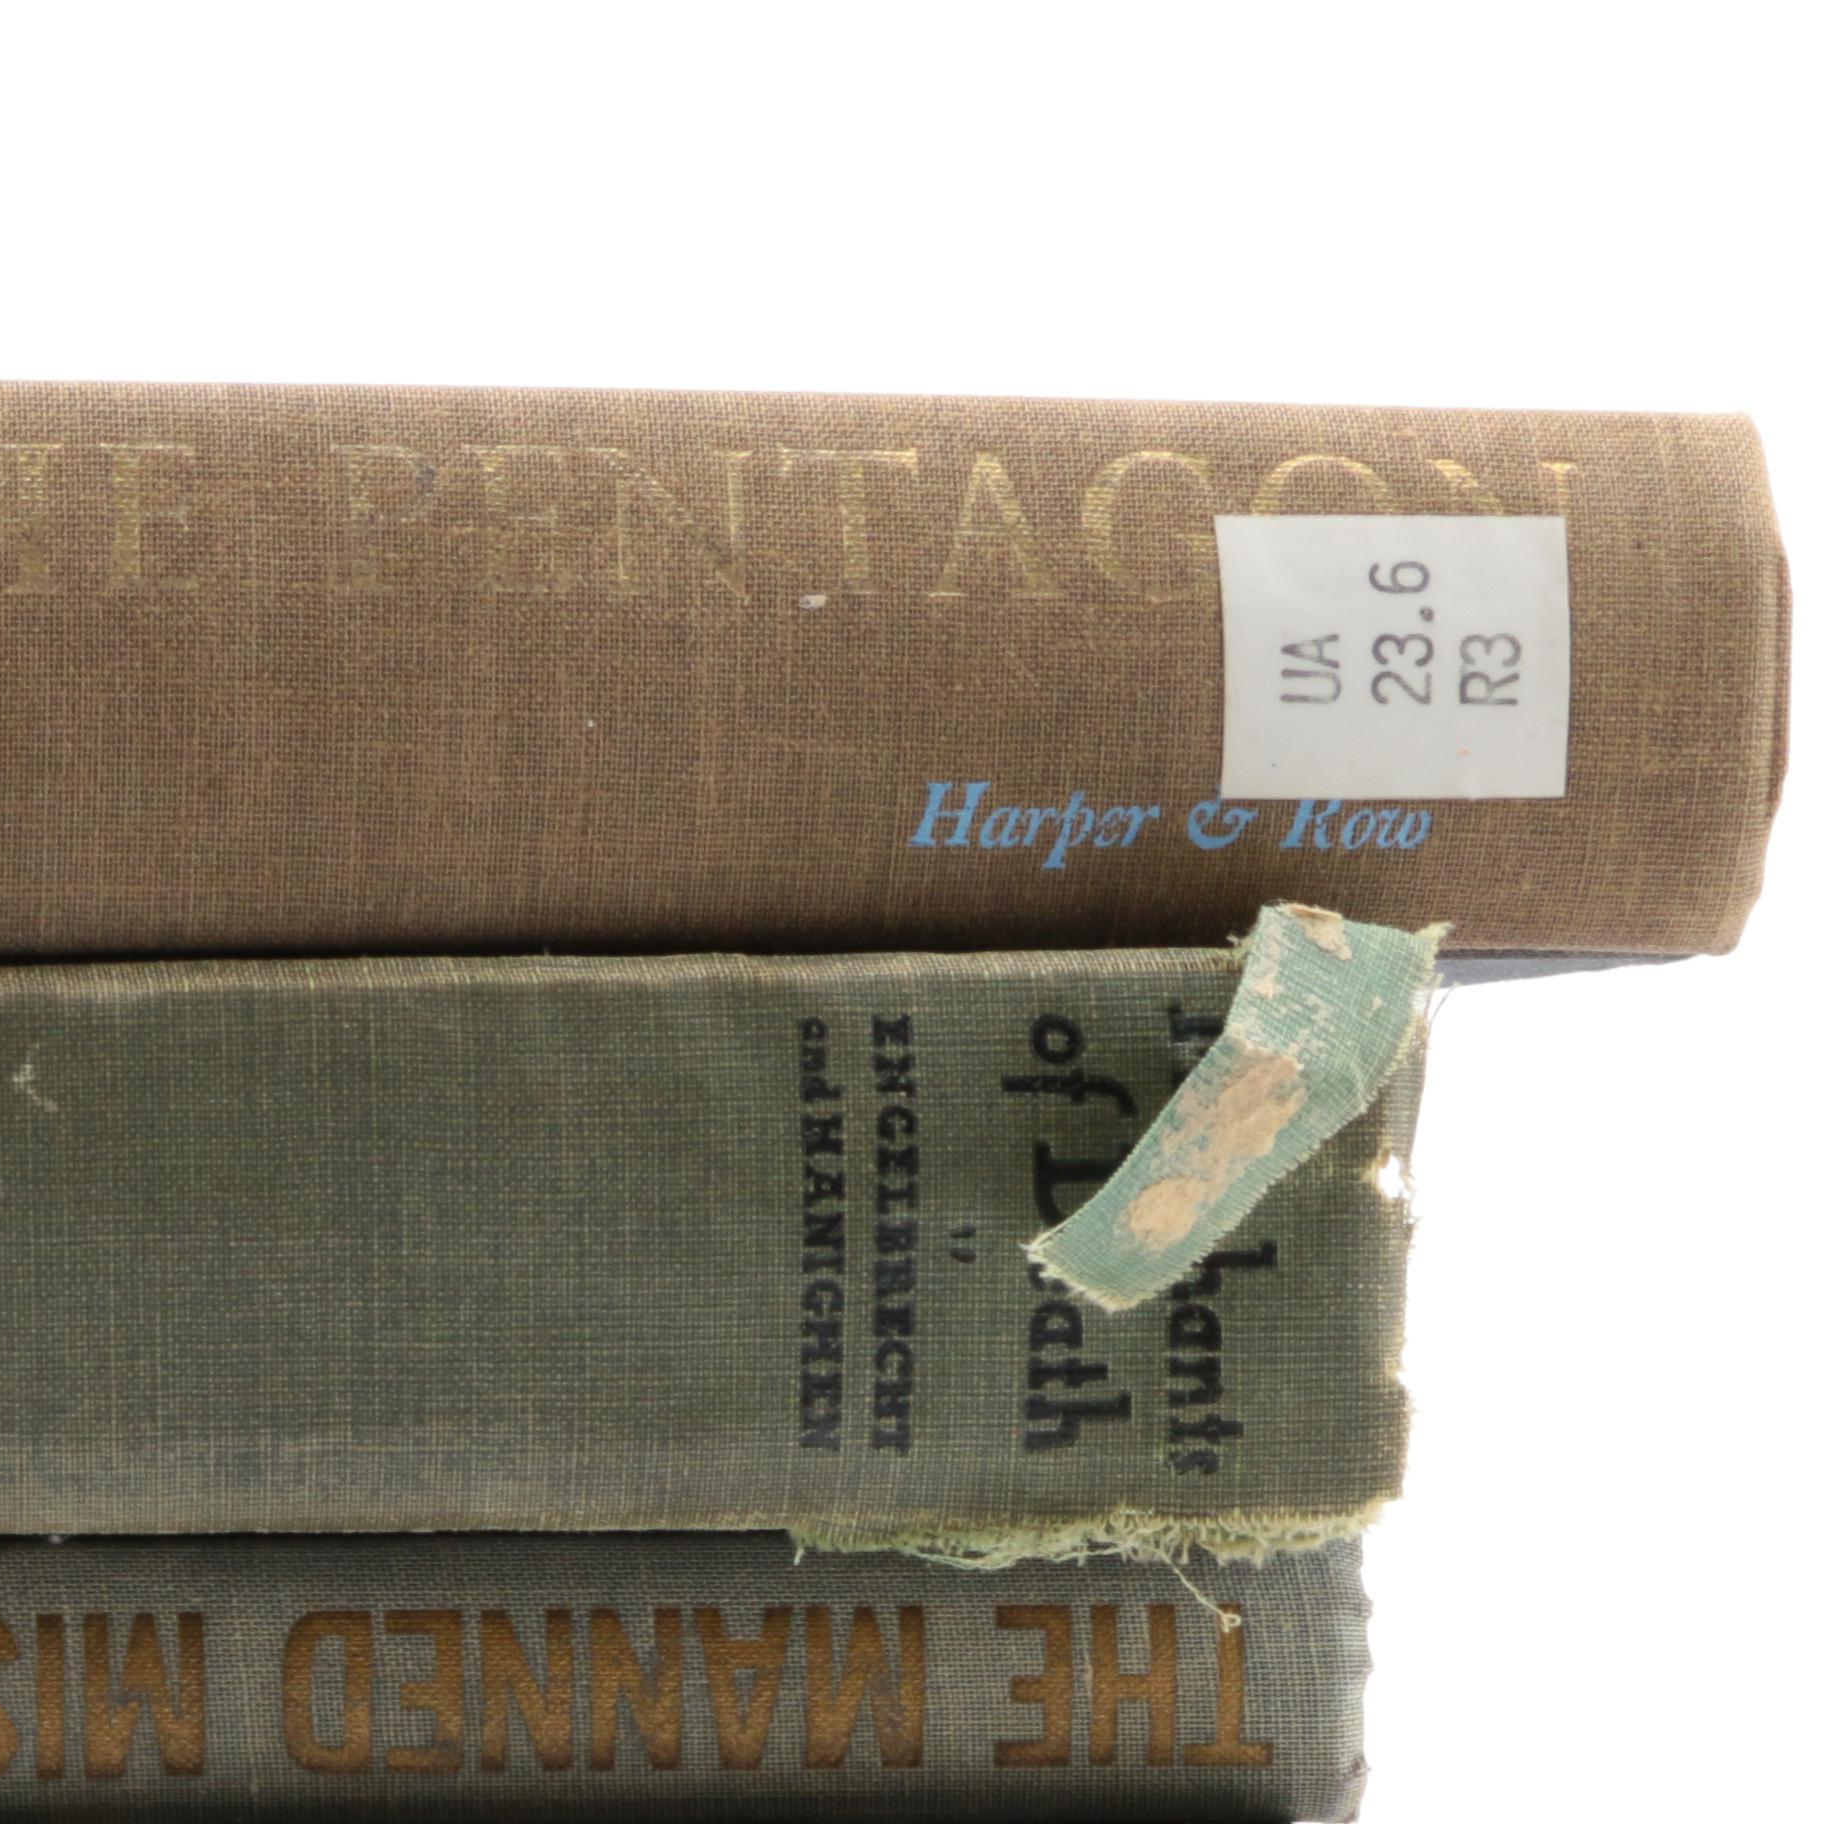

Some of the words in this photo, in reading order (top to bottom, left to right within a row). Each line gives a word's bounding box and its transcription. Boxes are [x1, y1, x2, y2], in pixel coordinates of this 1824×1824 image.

[1279, 633, 1343, 704] UA
[1368, 559, 1435, 706] 23.6
[1458, 632, 1523, 707] R3
[910, 780, 1159, 867] Harper
[1187, 788, 1258, 849] &
[1280, 799, 1433, 849] Row
[799, 1017, 842, 1102] and
[1002, 1014, 1137, 1119] of
[799, 1114, 845, 1451] HANIGHEN
[872, 1014, 919, 1455] ENGELBRECHT
[283, 1604, 925, 1774] MANNED
[994, 1602, 1273, 1768] THE
